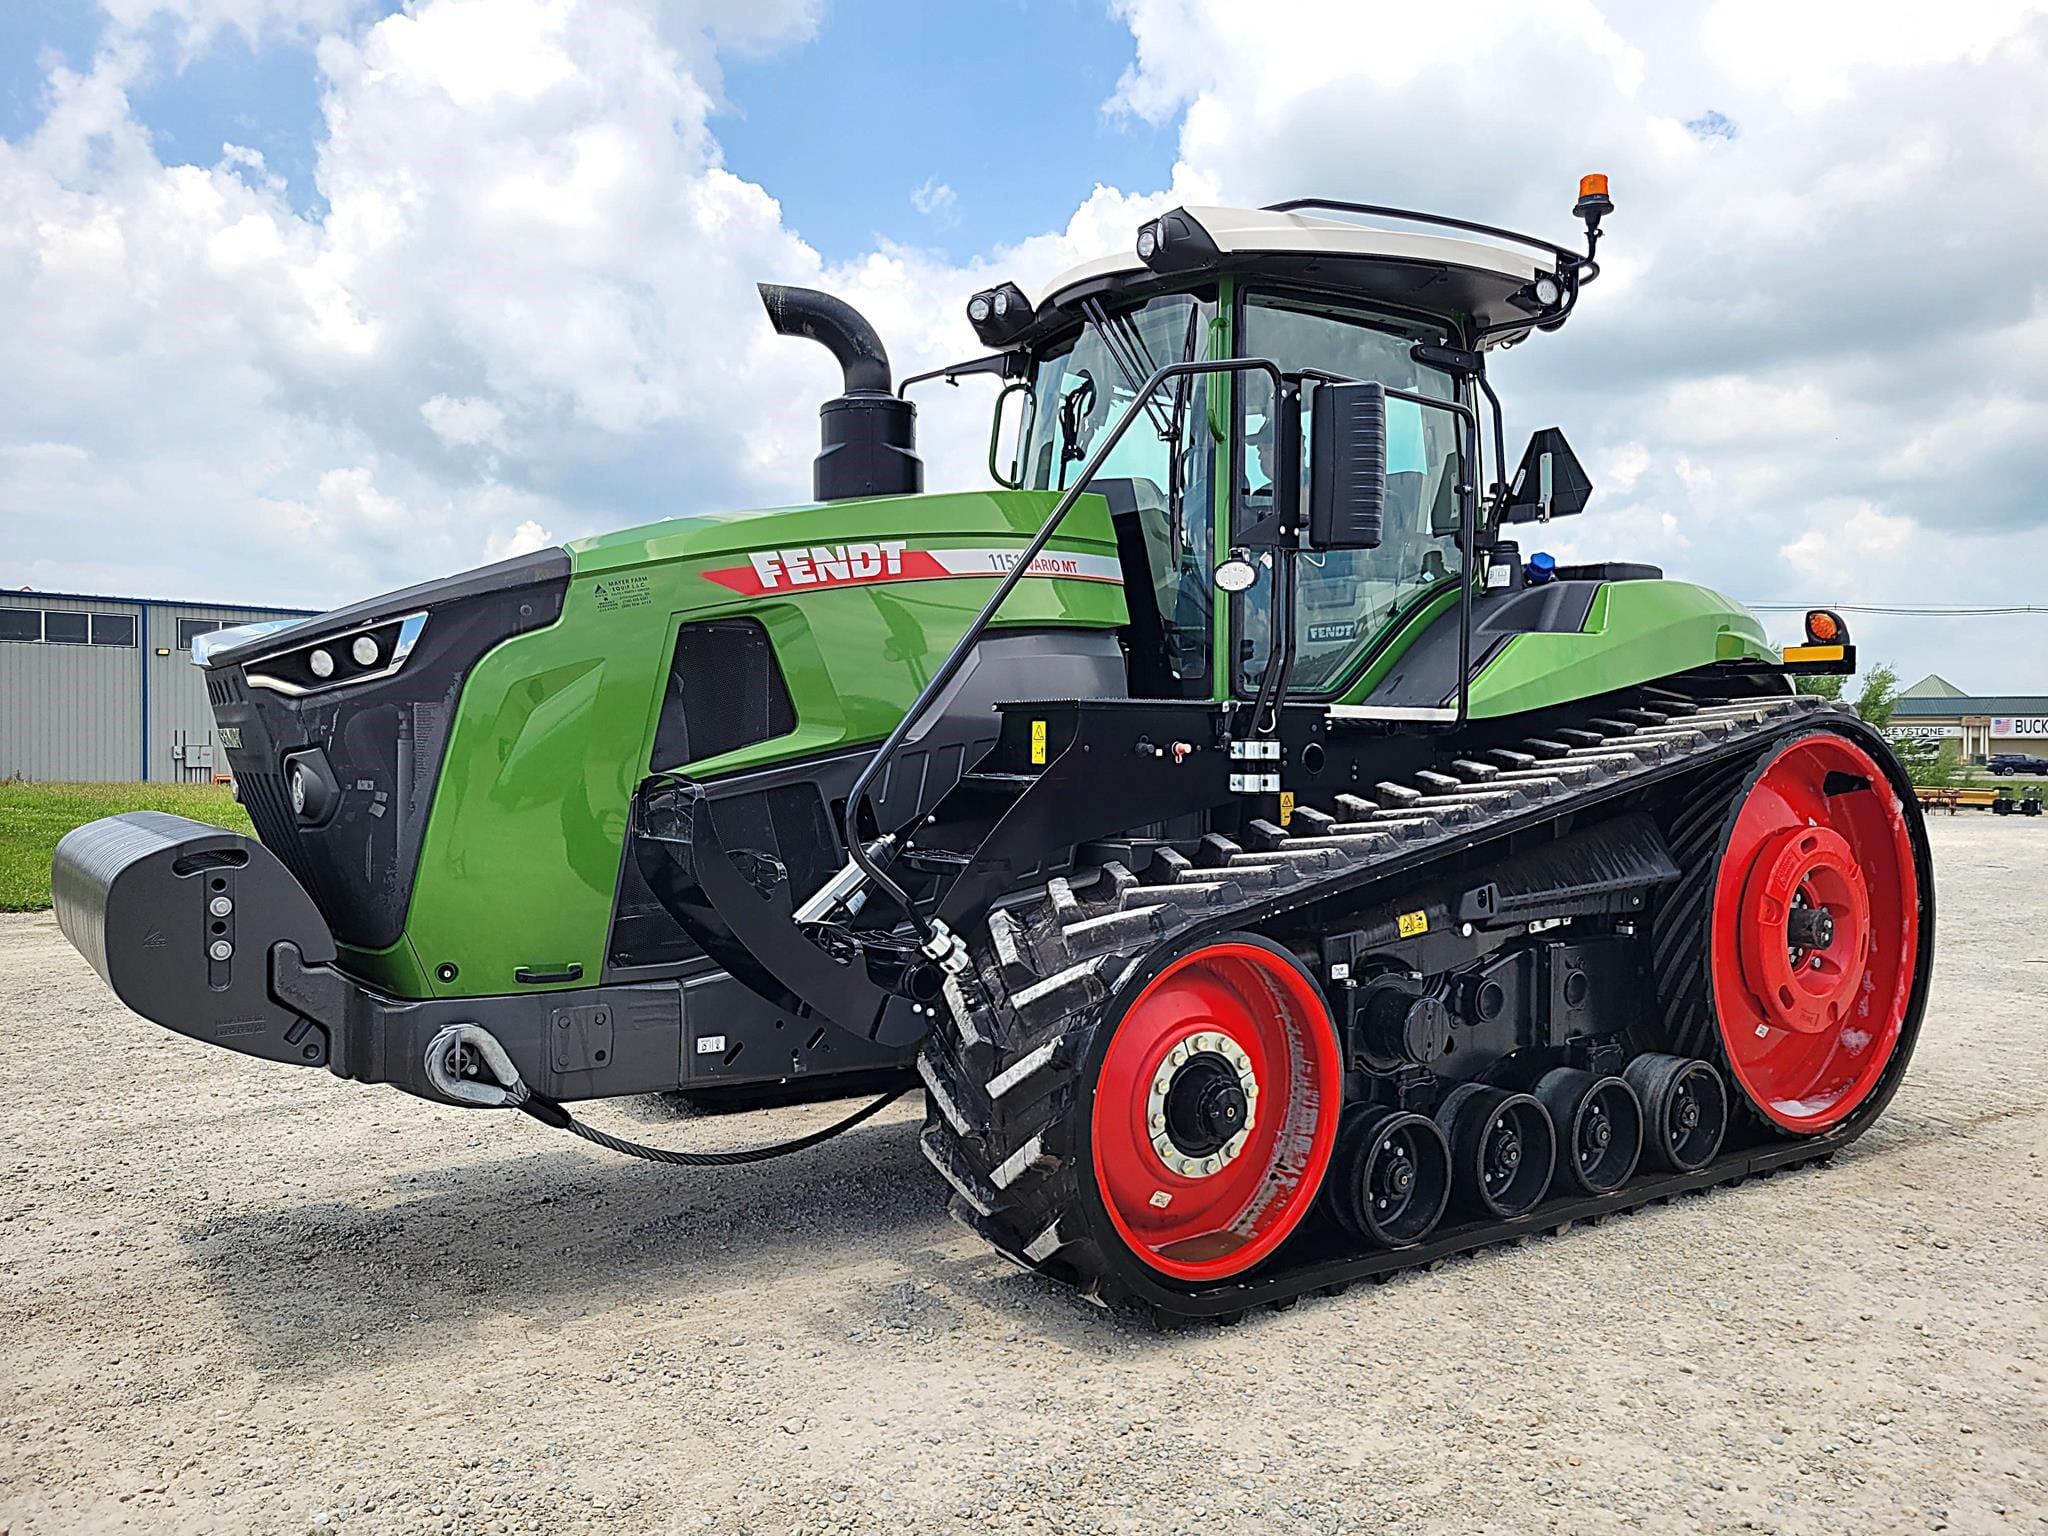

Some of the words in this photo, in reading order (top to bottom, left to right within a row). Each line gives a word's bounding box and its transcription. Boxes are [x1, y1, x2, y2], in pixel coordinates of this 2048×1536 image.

[748, 541, 906, 588] FENDT
[1061, 560, 1077, 573] MT
[1310, 625, 1354, 639] FENDT
[1885, 727, 1945, 736] KEYSTONE
[2015, 719, 2048, 734] BUCK
